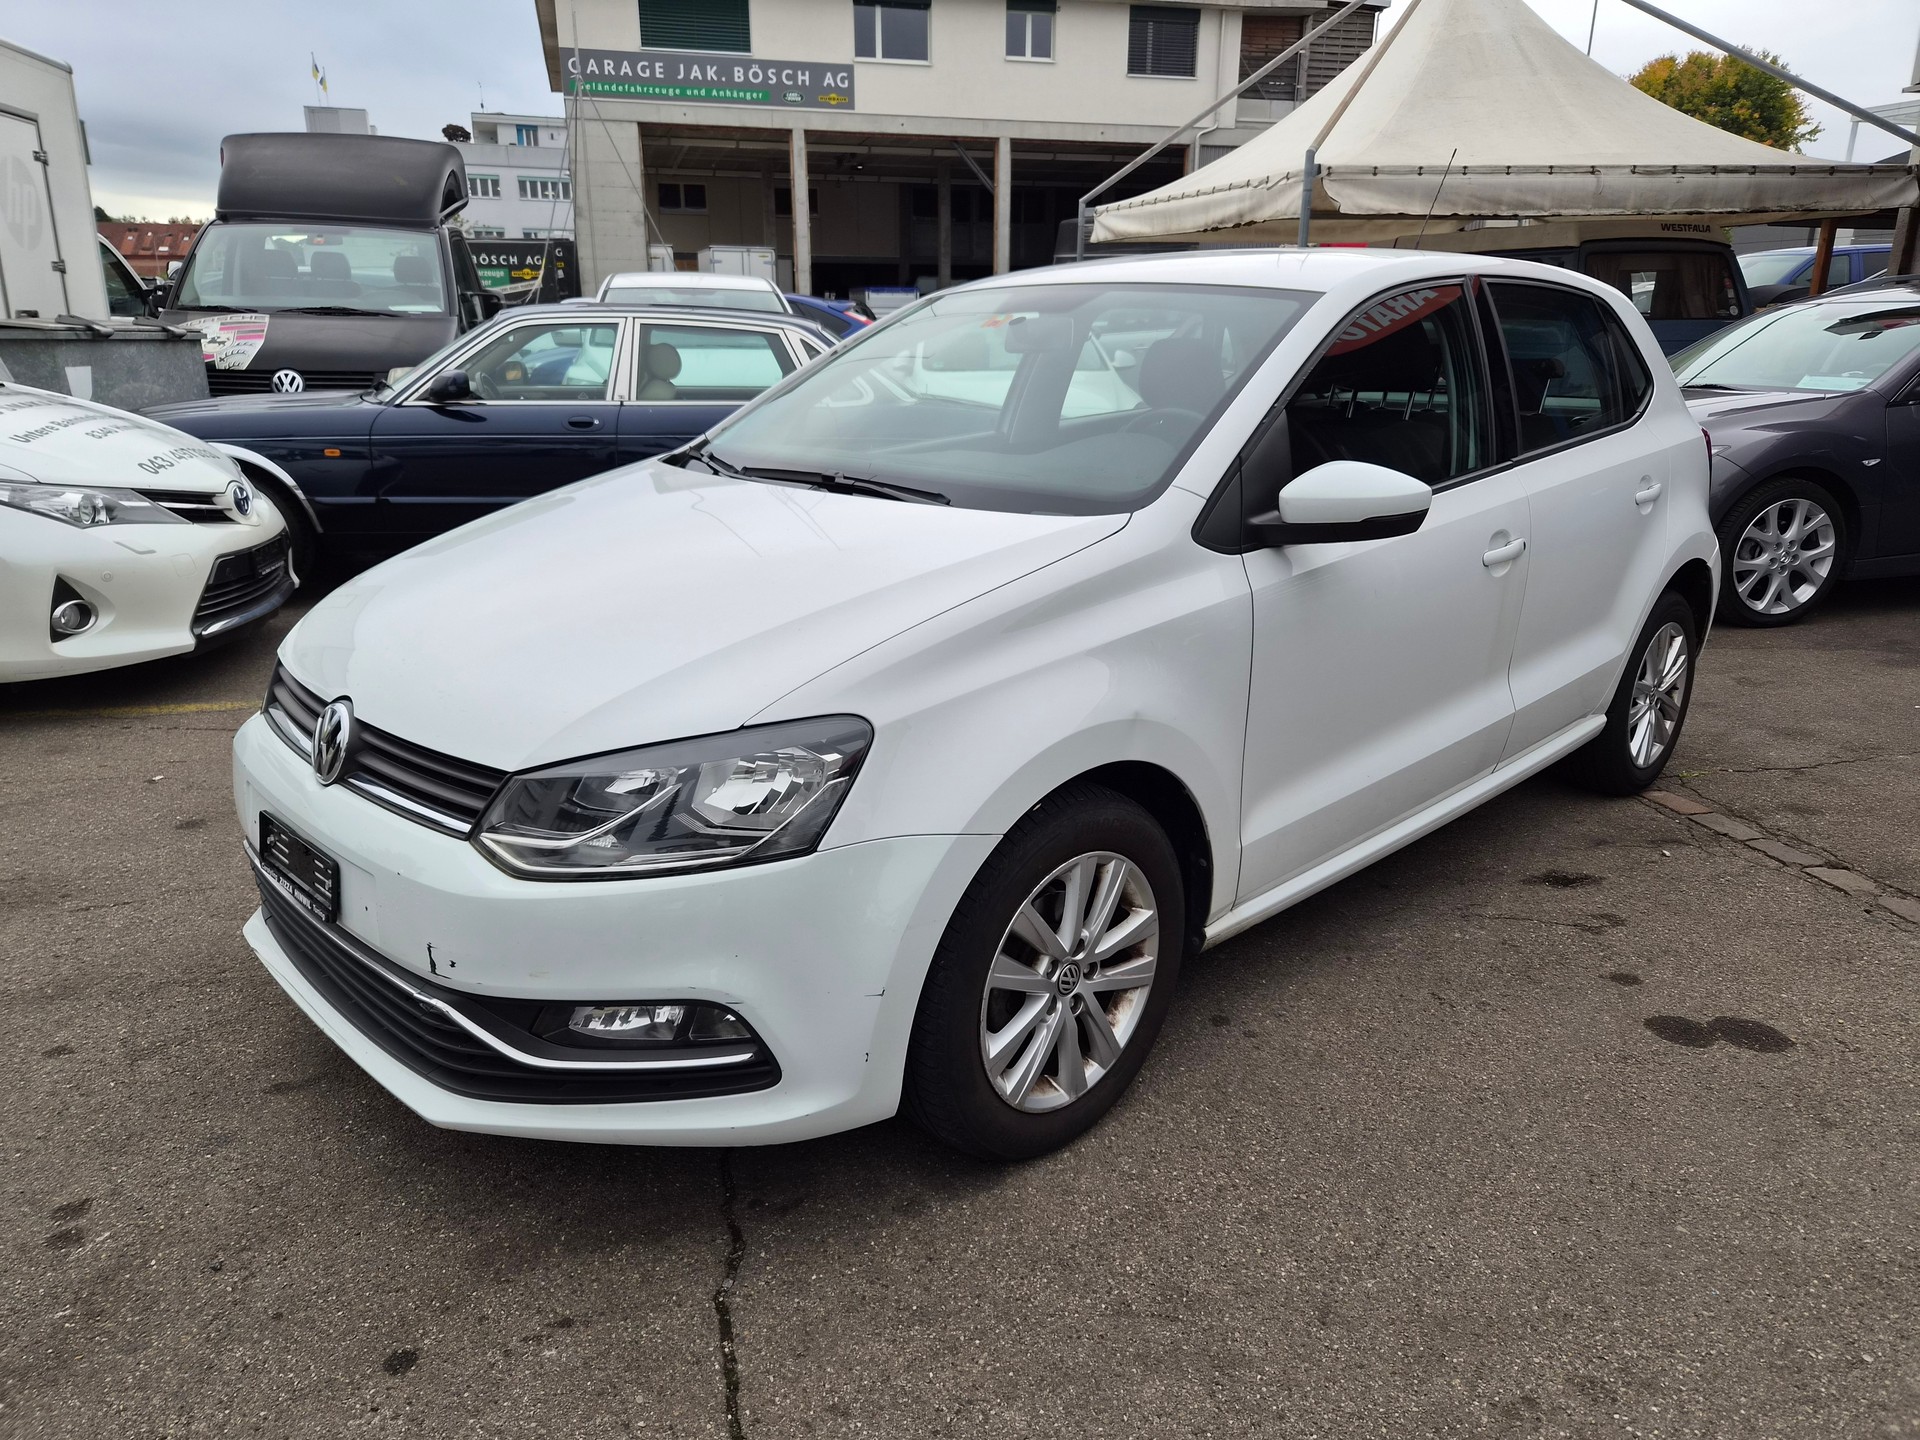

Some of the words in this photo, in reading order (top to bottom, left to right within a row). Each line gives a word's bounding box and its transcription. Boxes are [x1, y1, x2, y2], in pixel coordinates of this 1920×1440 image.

[567, 57, 665, 79] GARAGE
[677, 63, 726, 83] JAK.
[733, 63, 811, 87] BÖSCH
[823, 71, 850, 89] AG
[686, 89, 706, 97] und
[711, 90, 764, 101] Anhänger
[1661, 223, 1711, 233] WESTFALIA
[526, 255, 542, 265] AG
